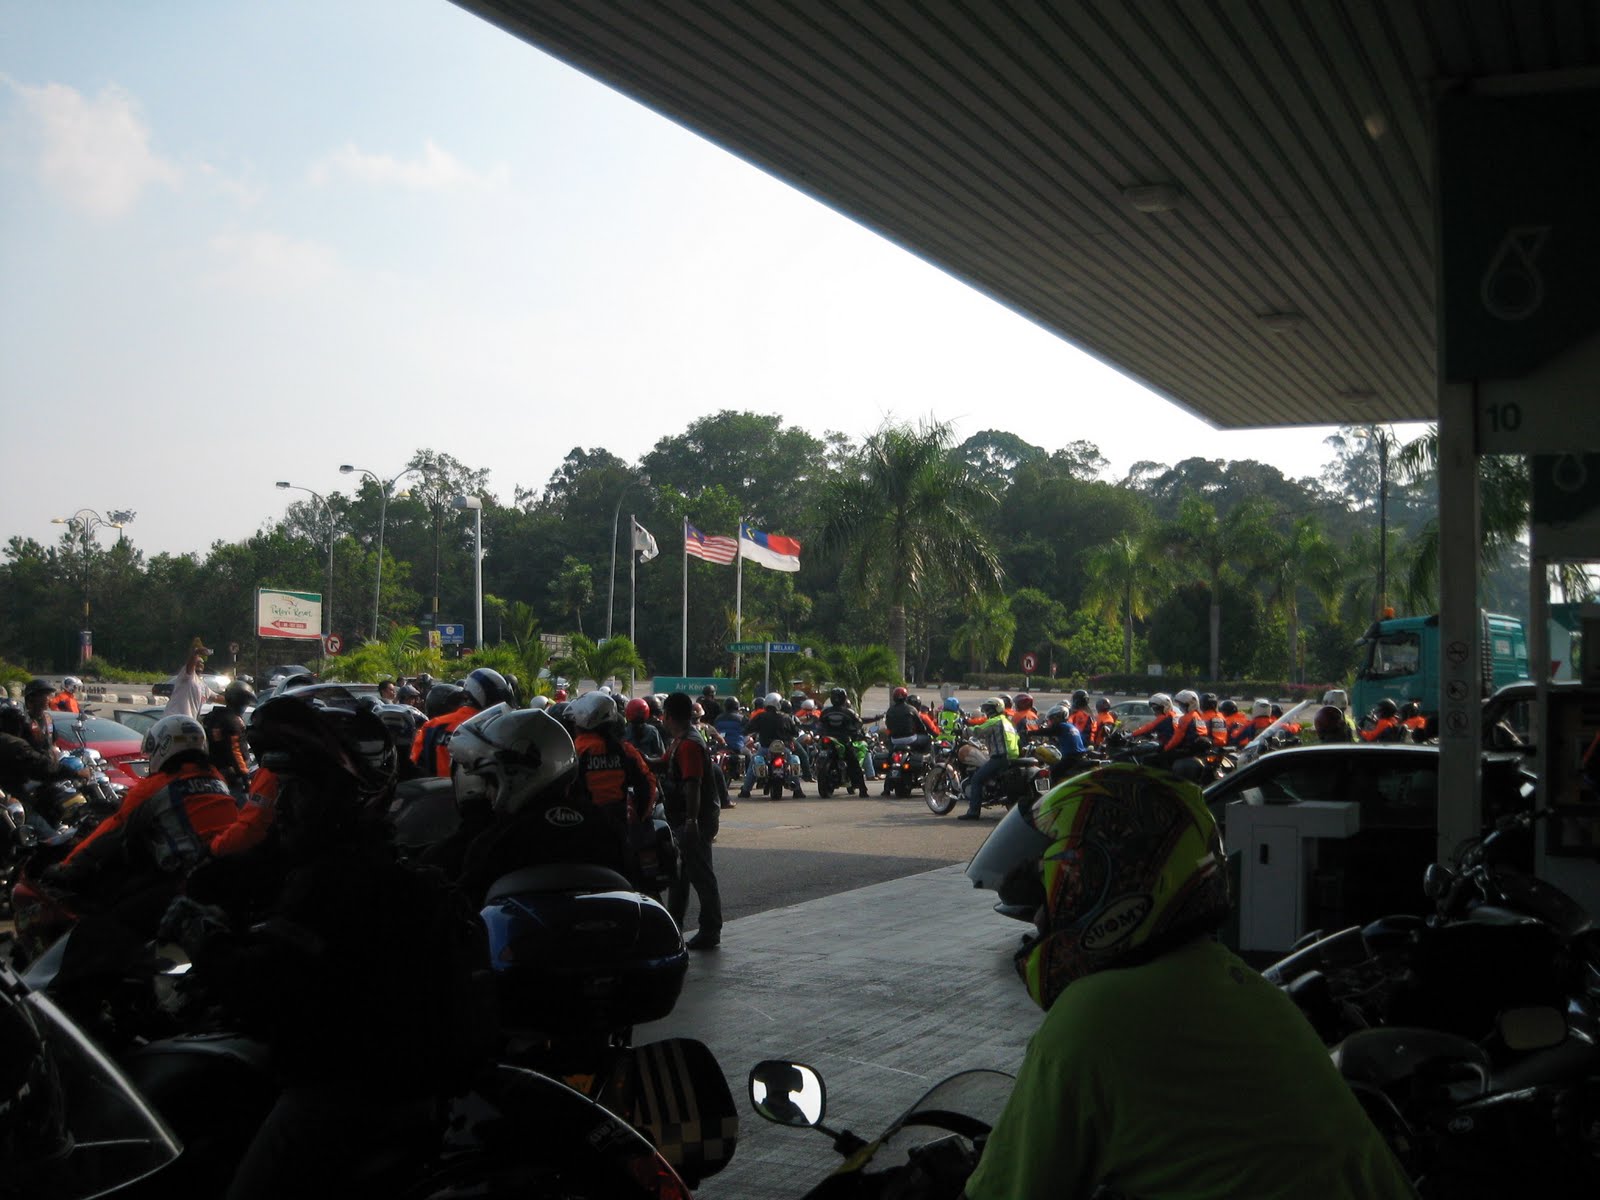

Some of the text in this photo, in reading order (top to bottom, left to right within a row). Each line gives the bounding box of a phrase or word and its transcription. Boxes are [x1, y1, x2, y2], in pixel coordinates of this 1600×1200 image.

[1486, 402, 1522, 433] 10
[676, 682, 687, 691] Air
[1085, 902, 1146, 945] SUOMY
